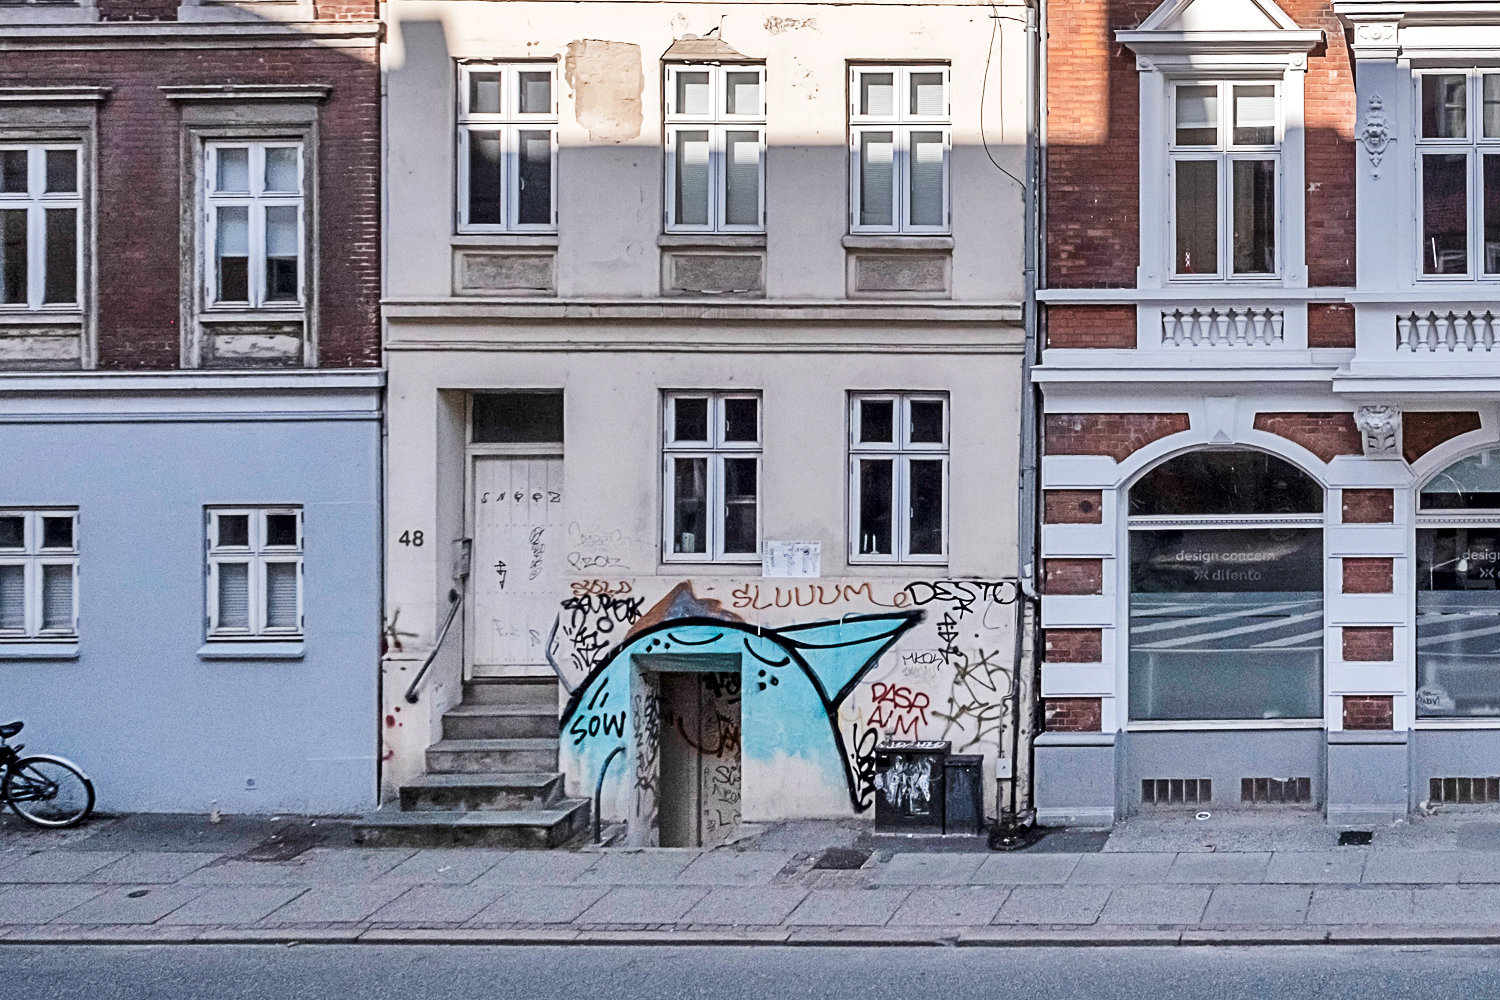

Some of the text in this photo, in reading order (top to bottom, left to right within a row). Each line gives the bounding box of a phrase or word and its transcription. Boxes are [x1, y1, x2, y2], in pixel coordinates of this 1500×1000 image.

[398, 530, 425, 548] 48
[1175, 549, 1219, 563] design
[1212, 568, 1262, 580] difento
[569, 710, 627, 745] SOW
